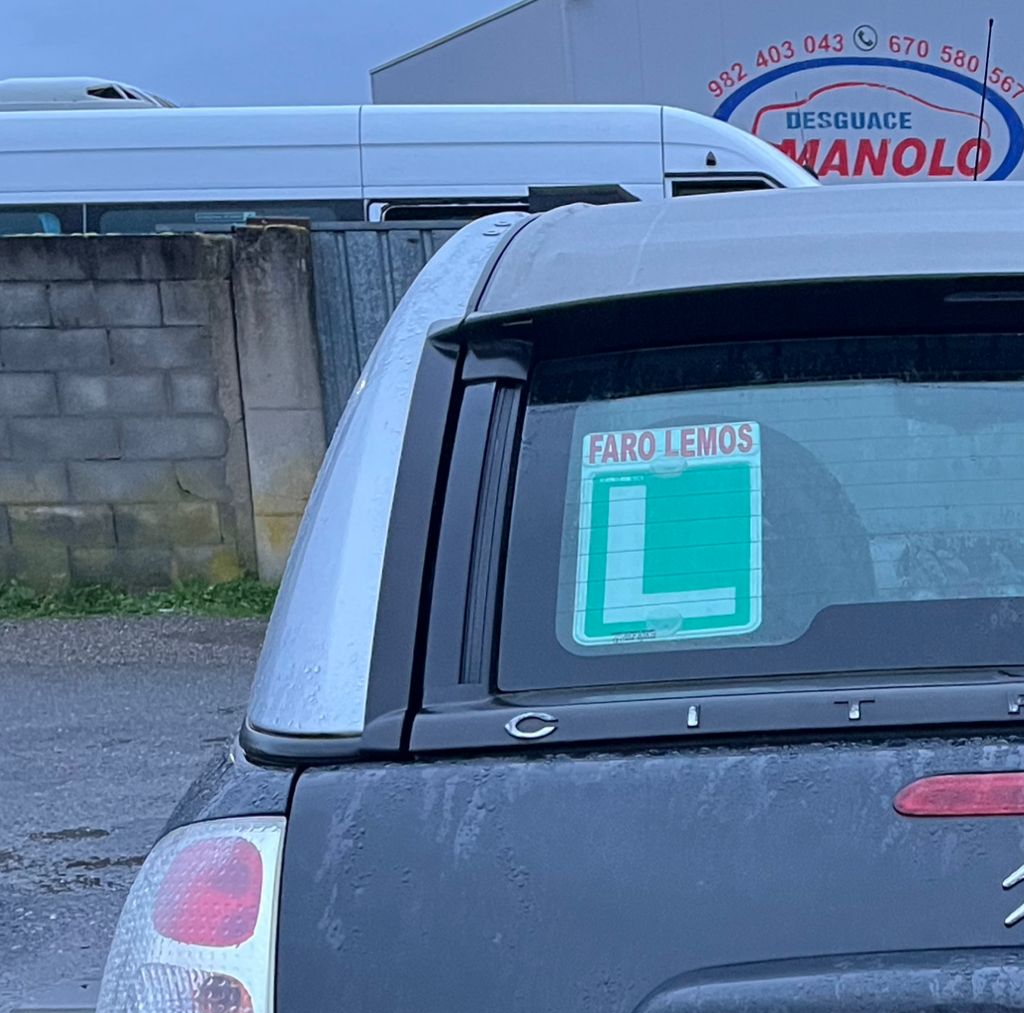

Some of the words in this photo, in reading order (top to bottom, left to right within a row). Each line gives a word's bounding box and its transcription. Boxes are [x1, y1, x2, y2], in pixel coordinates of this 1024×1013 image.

[707, 63, 747, 98] 982
[755, 40, 795, 69] 403
[804, 34, 844, 53] 043
[888, 35, 929, 58] 670
[939, 45, 979, 73] 580
[786, 111, 912, 130] DESGUACE
[777, 137, 992, 177] MANOLO
[588, 431, 656, 464] FARO
[664, 423, 753, 458] LEMOS
[603, 485, 736, 624] L
